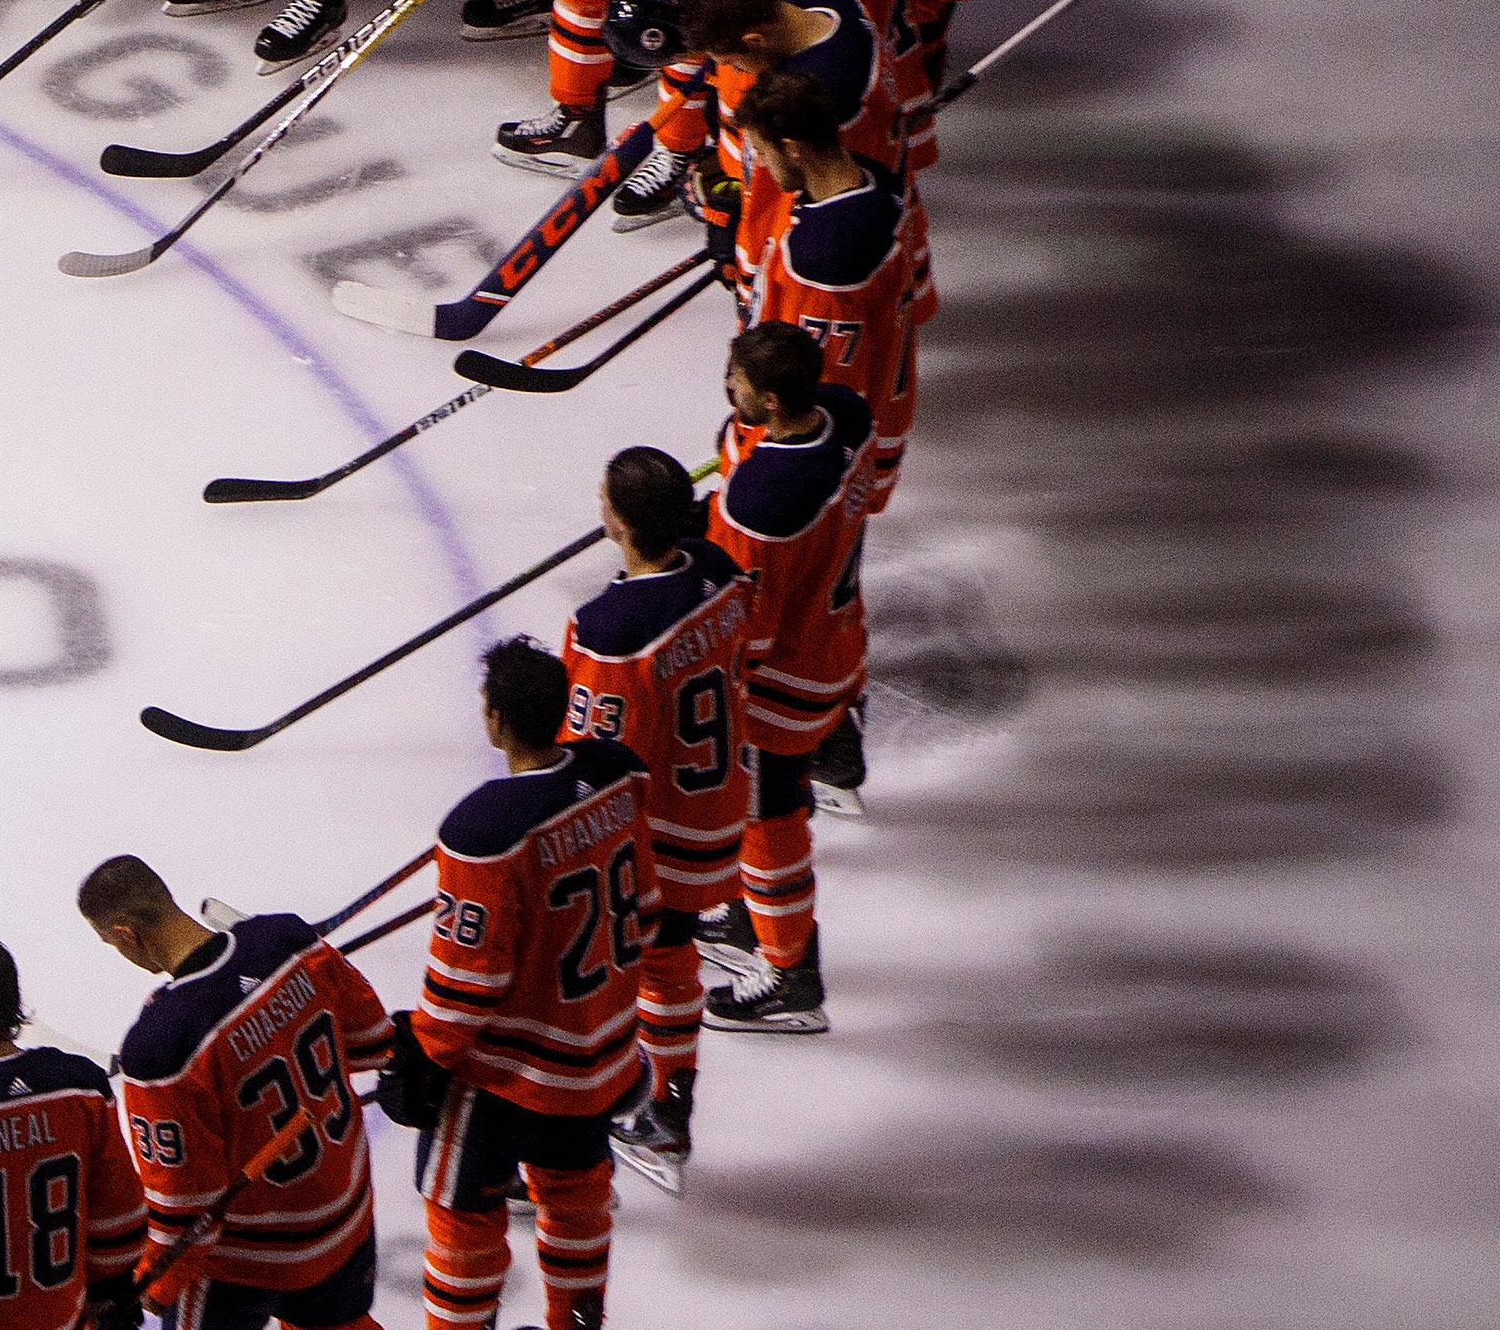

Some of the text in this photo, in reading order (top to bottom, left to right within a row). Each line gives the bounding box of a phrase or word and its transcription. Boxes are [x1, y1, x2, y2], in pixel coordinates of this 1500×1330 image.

[499, 152, 621, 292] CCM
[567, 683, 627, 742] 93
[434, 888, 490, 949] 28
[548, 836, 644, 1004] 28
[226, 969, 319, 1064] CHIASSON
[130, 1112, 188, 1171] 39
[235, 1008, 355, 1189] 39
